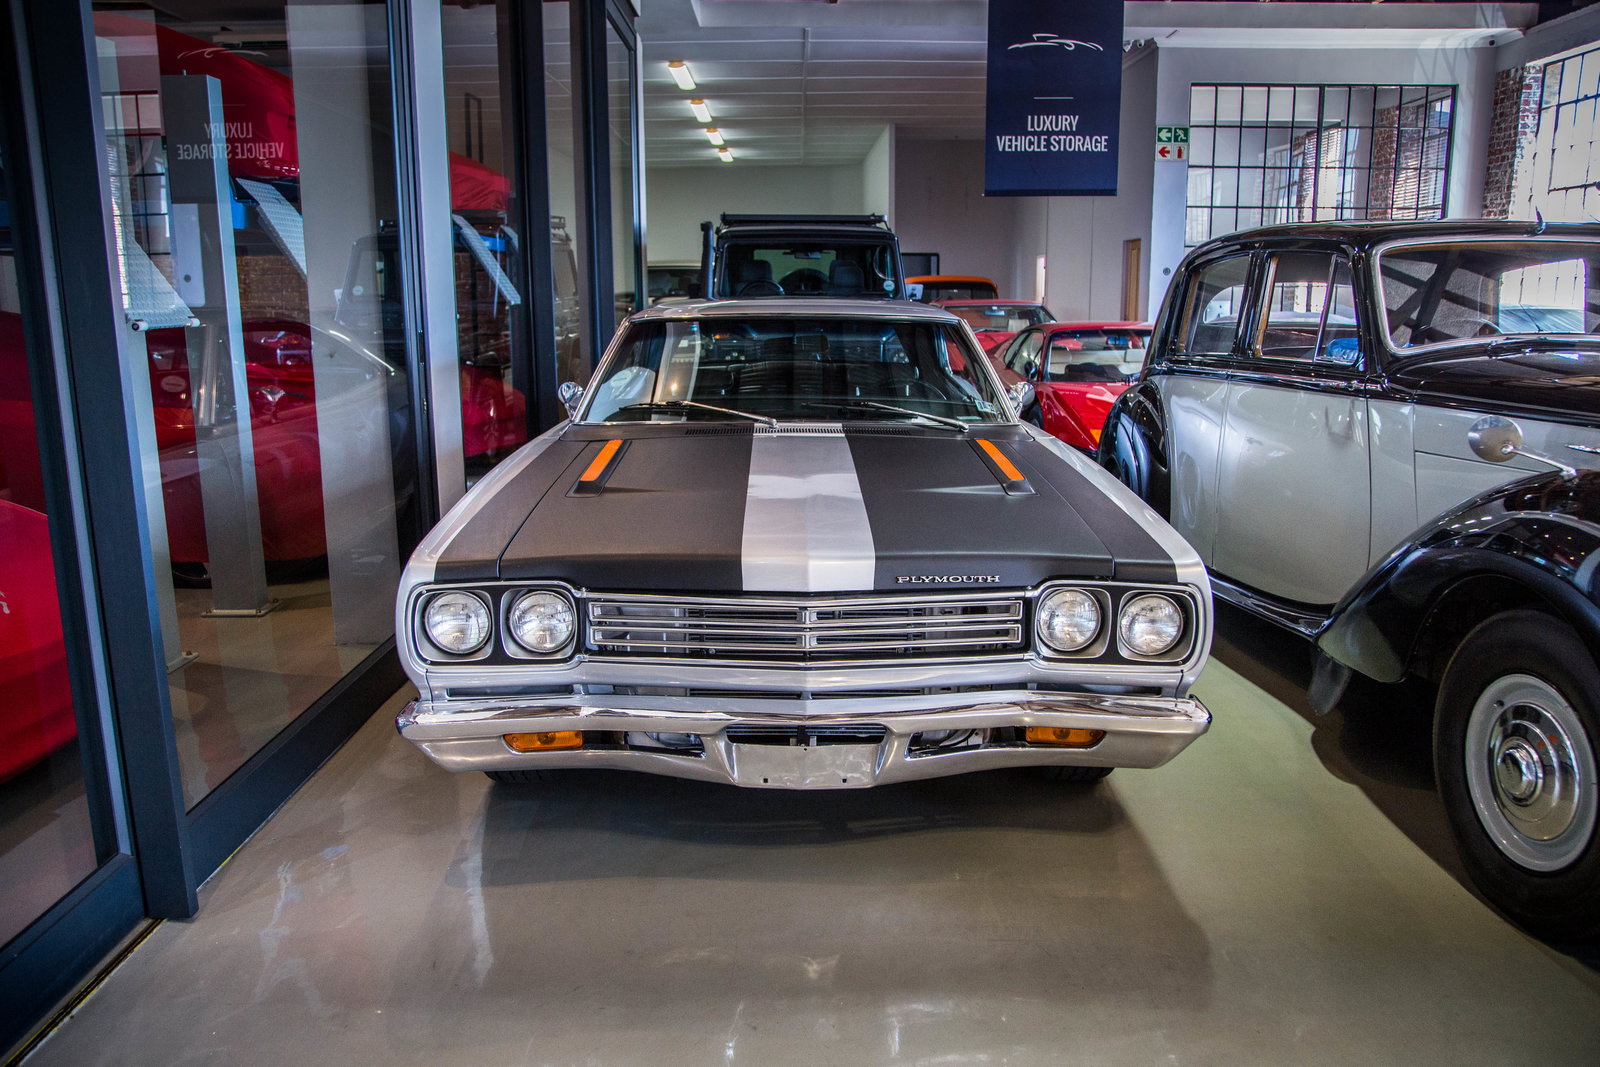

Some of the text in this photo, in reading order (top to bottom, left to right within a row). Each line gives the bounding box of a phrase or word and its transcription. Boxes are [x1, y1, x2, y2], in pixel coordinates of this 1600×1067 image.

[1028, 115, 1079, 131] LUXURY
[996, 135, 1108, 152] VEHICLE STORAGE
[896, 575, 1001, 584] PLYMOUTH
